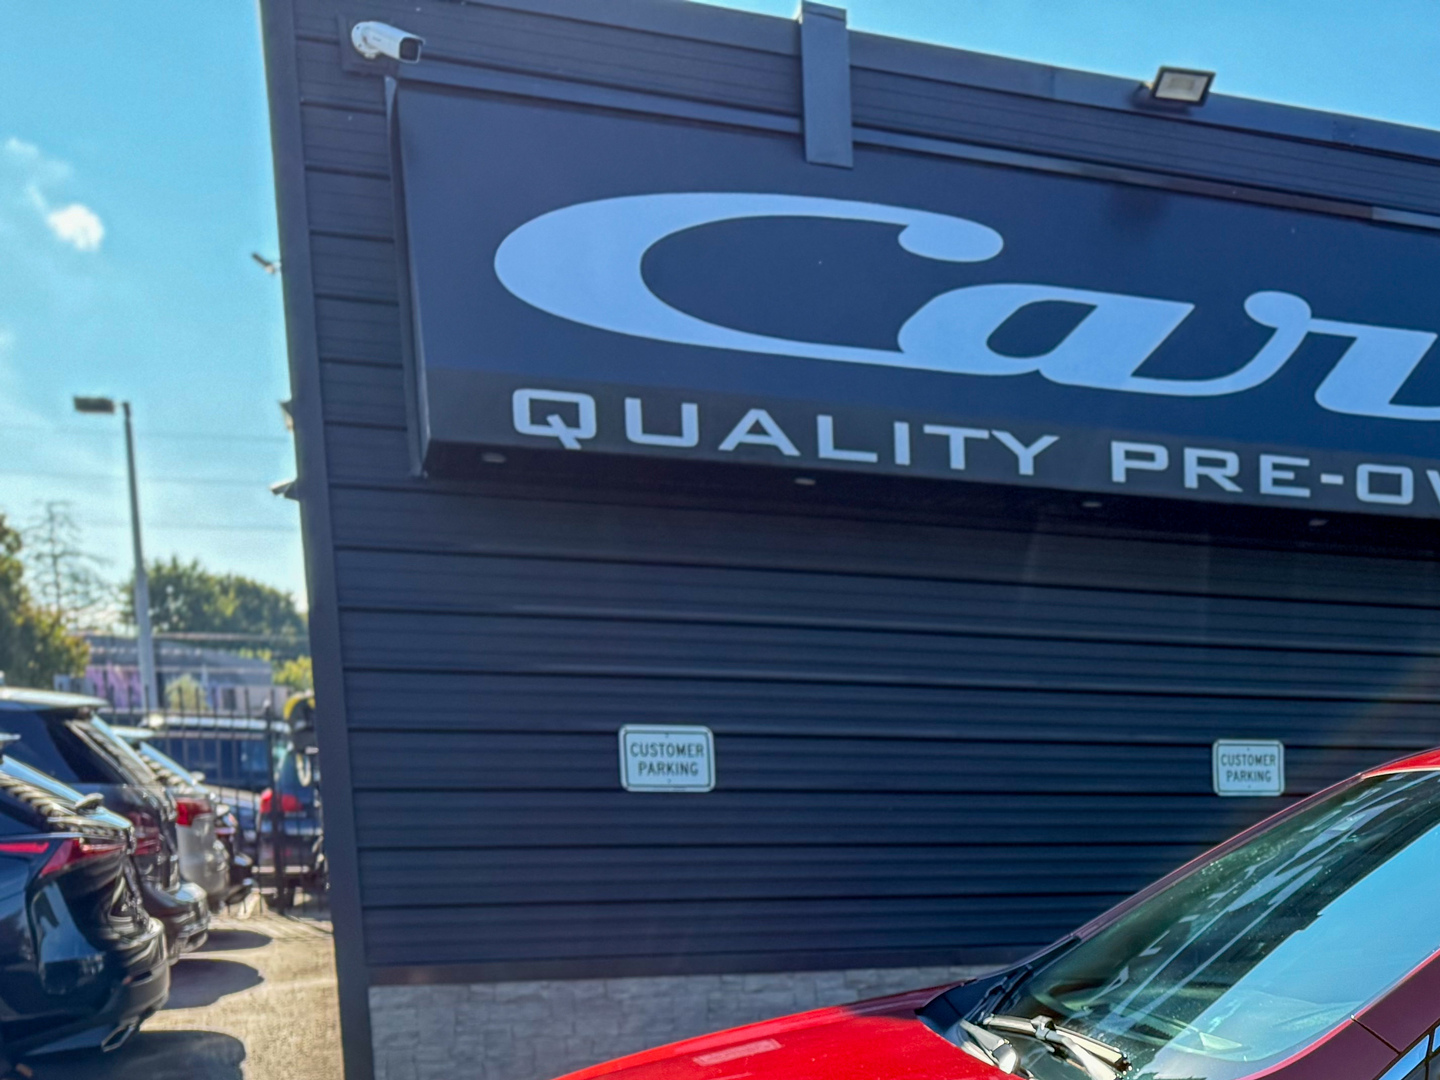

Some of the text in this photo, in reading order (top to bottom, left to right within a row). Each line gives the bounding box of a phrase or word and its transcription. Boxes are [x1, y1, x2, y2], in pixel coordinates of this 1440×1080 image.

[512, 388, 1059, 475] QUALITY
[630, 742, 704, 758] CUSTOMER
[1221, 753, 1276, 767] CUSTOMER
[638, 761, 699, 776] PARKING
[1226, 770, 1272, 783] PARKING
